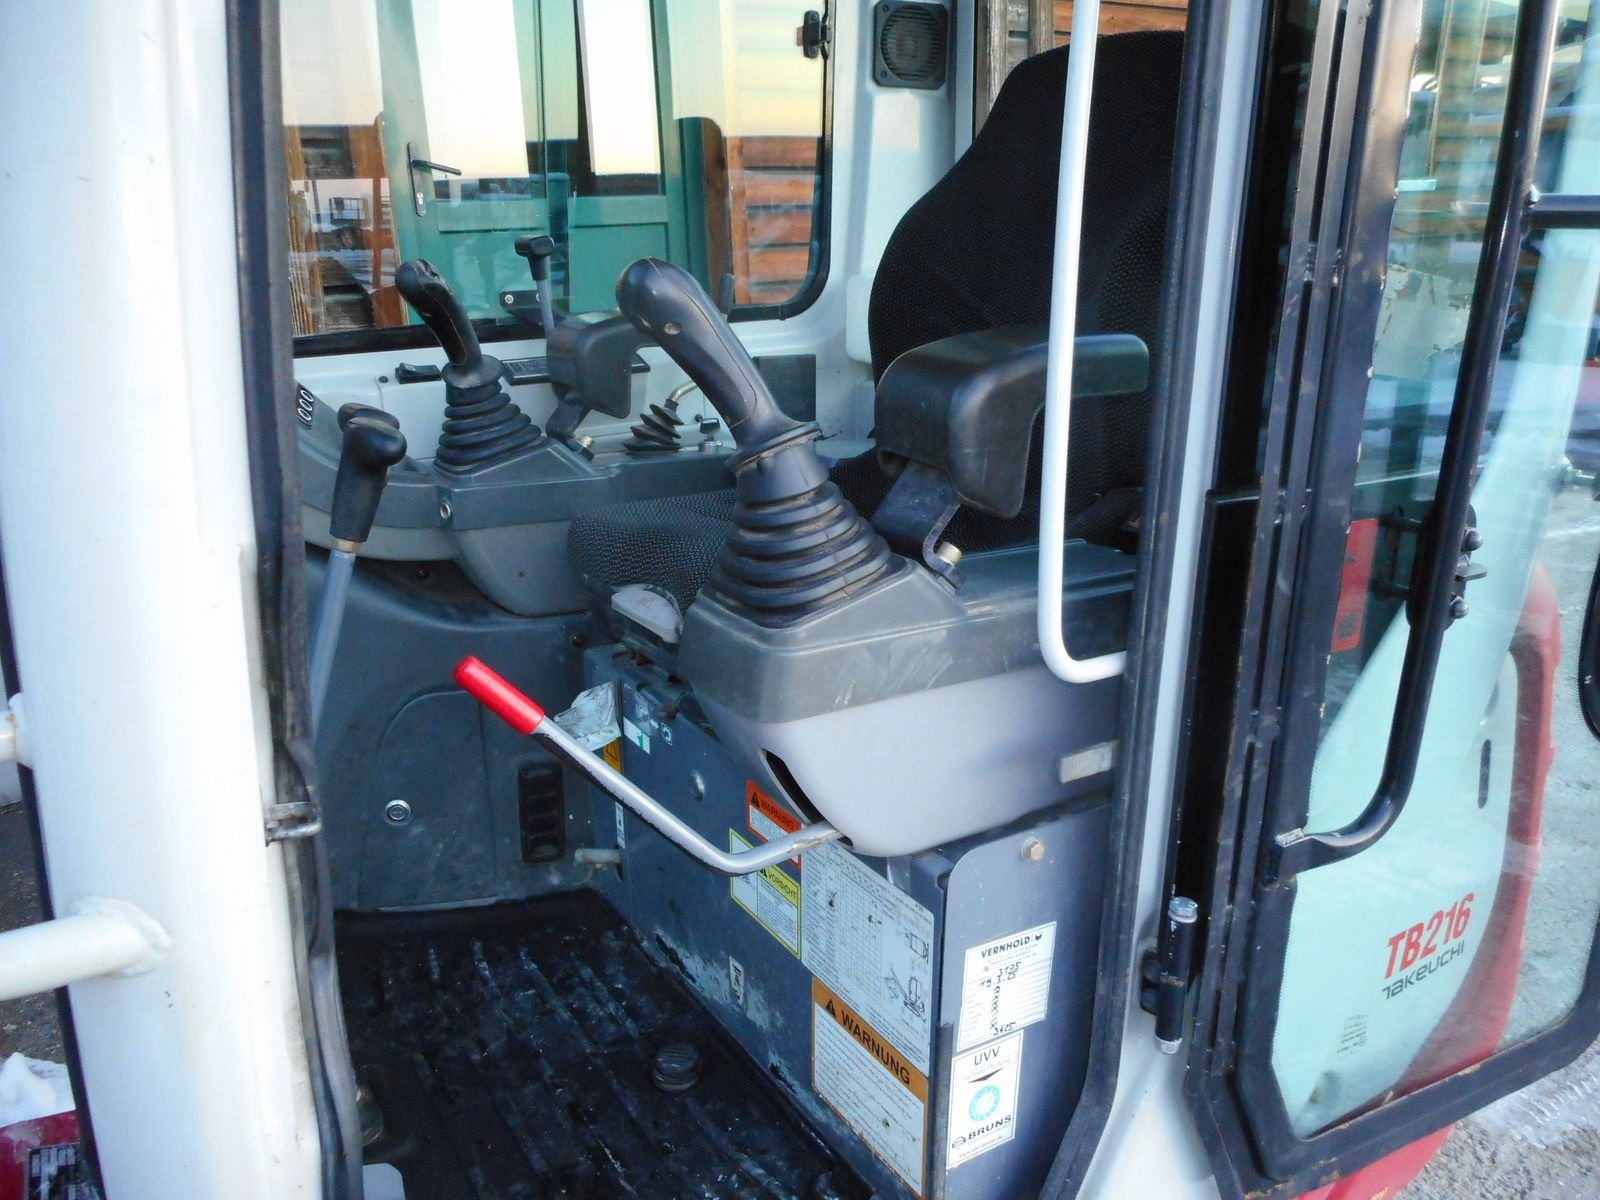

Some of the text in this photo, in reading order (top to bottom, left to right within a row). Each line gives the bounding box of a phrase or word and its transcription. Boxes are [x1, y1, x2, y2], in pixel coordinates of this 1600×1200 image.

[767, 872, 798, 900] VORSICHT
[981, 935, 1031, 959] VERNHOLD
[1384, 892, 1475, 980] TB216
[841, 1009, 911, 1085] WARNUNG
[973, 1046, 1001, 1066] UVV
[968, 1114, 1012, 1141] BRUNS
